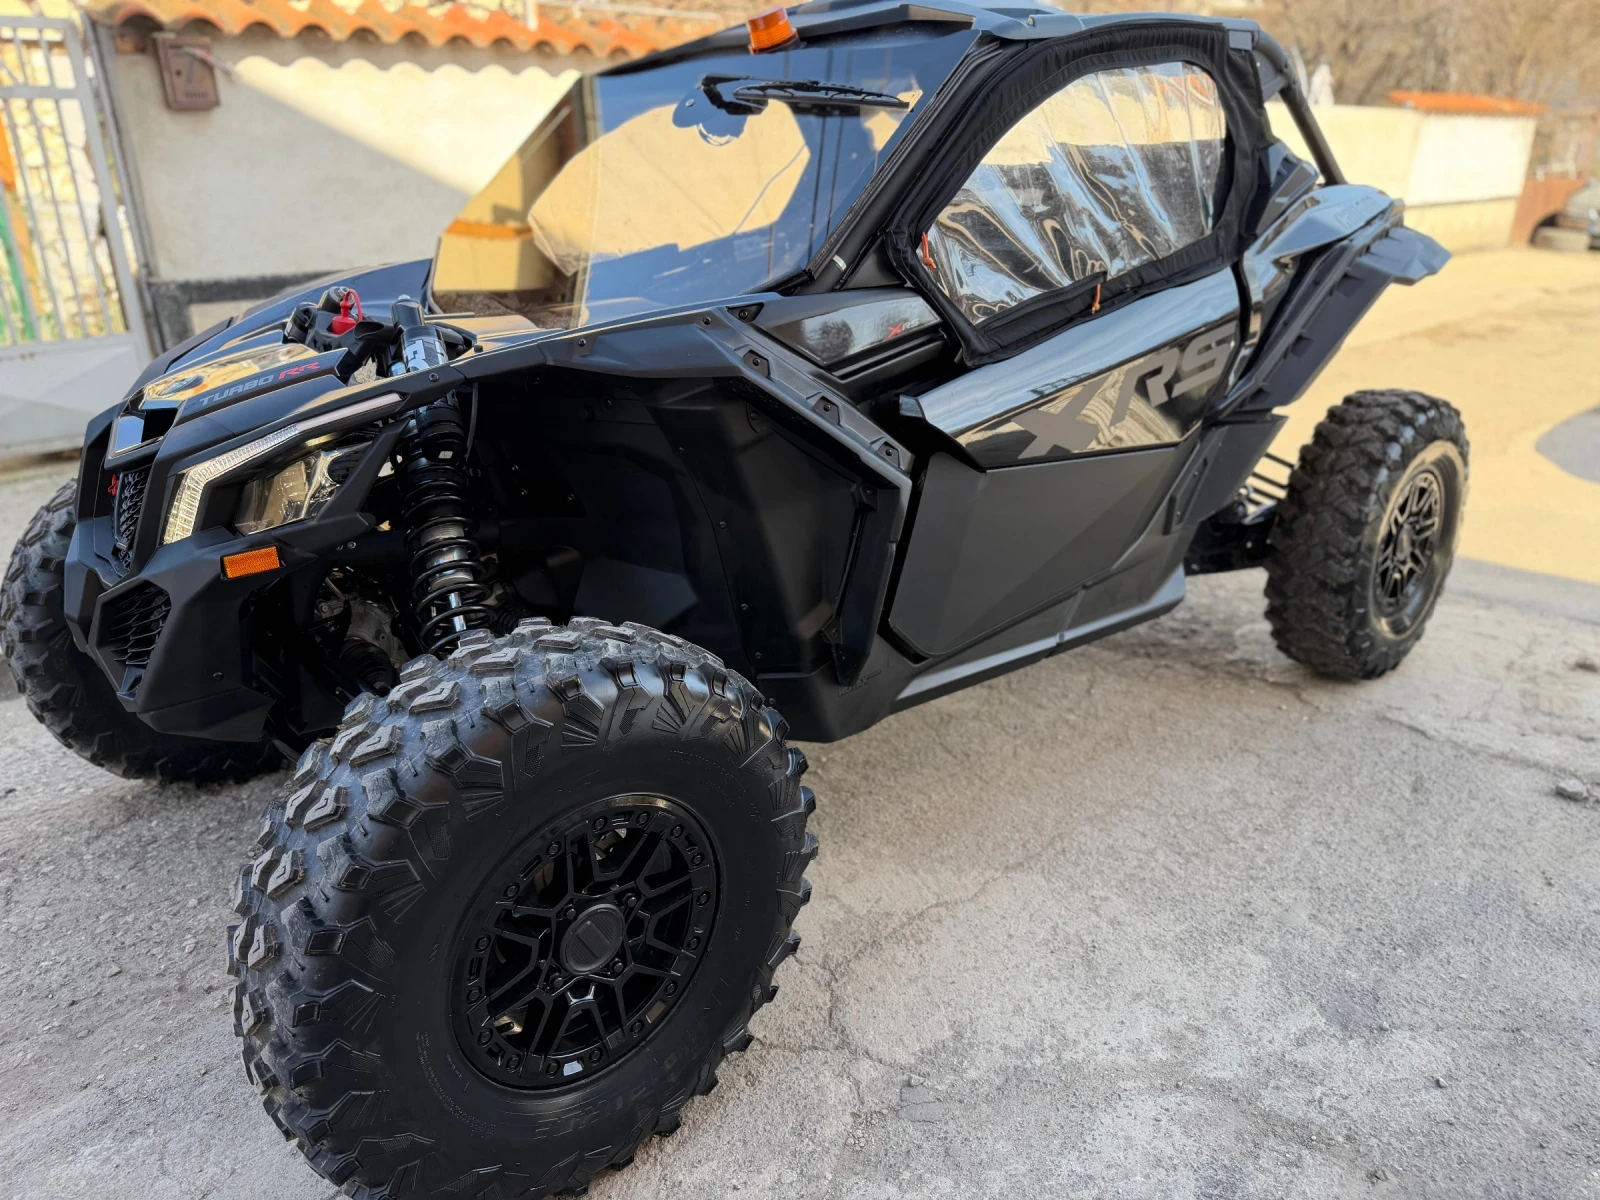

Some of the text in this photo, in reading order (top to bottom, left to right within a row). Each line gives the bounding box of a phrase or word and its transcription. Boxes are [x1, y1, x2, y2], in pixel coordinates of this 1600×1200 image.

[887, 318, 920, 339] XRS
[199, 361, 320, 406] TURBO RR
[1010, 320, 1238, 460] XRS
